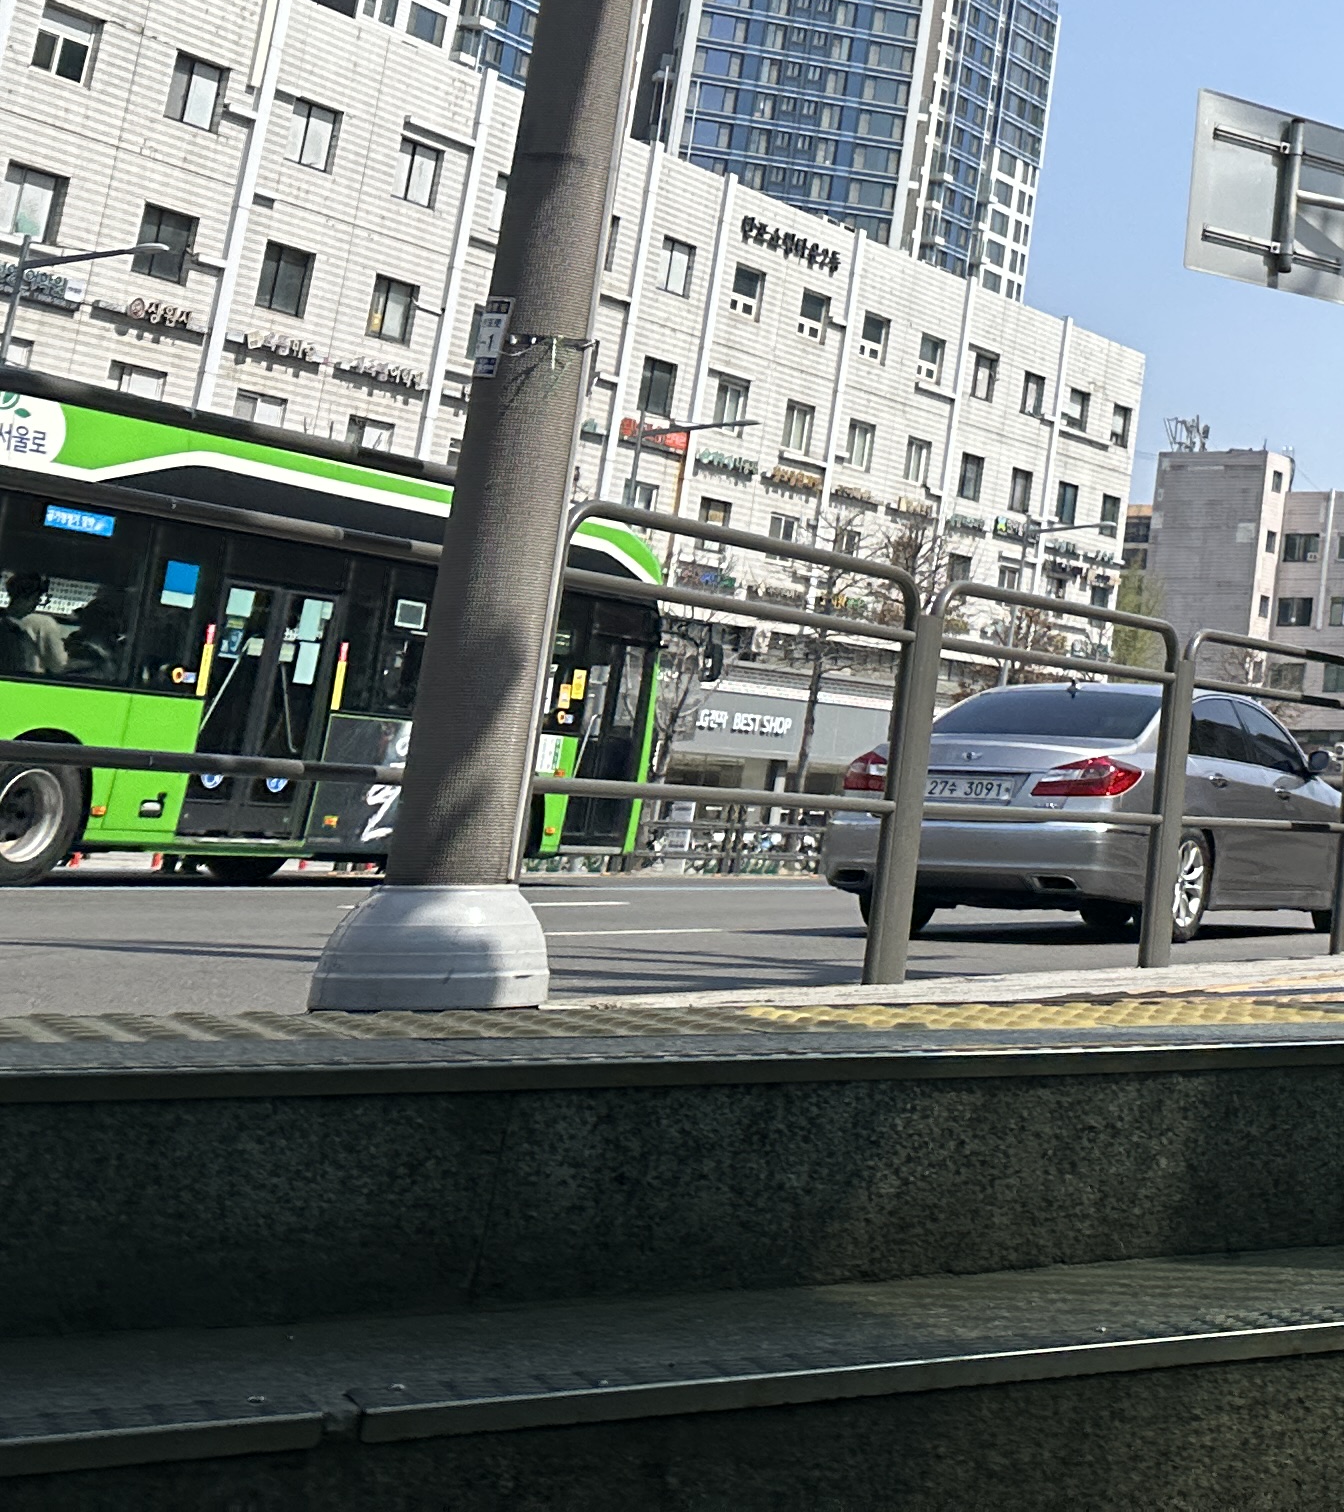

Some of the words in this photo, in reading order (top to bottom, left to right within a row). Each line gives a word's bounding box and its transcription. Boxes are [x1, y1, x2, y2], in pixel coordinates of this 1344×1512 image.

[732, 712, 762, 733] BEST
[761, 715, 793, 735] SHOP
[964, 781, 1002, 797] 3091
